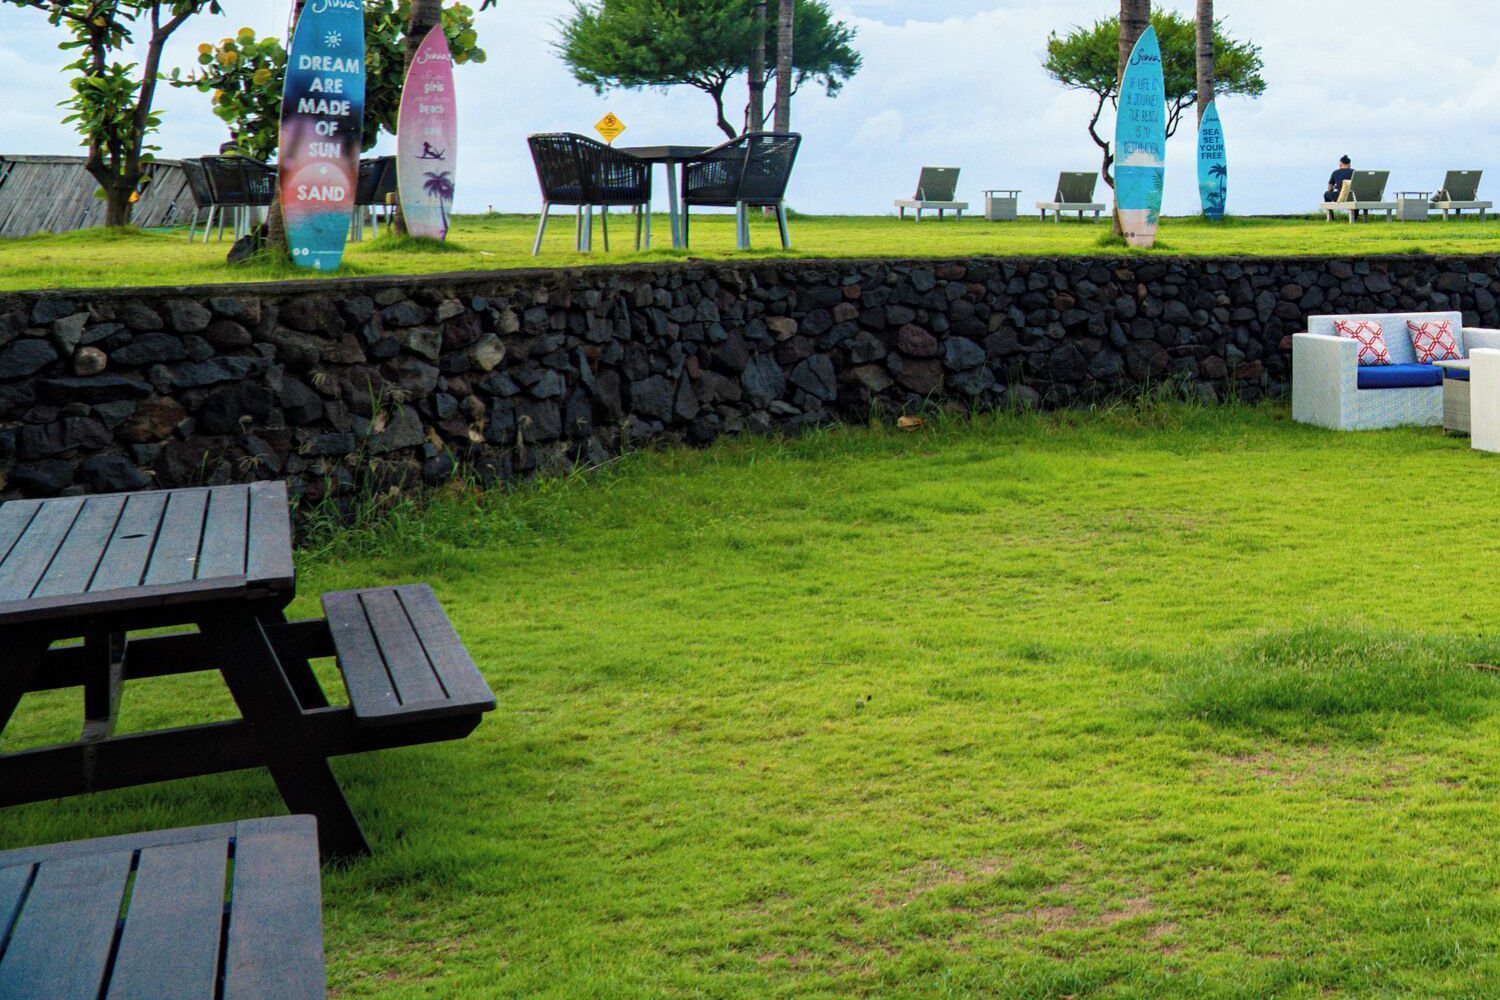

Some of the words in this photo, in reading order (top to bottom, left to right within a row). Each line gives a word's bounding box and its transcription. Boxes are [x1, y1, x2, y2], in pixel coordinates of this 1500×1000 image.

[298, 54, 360, 74] DREAM
[309, 77, 343, 95] ARE
[297, 98, 351, 116] MADE
[315, 120, 339, 137] OF
[1202, 128, 1220, 136] SEA
[308, 141, 341, 159] SUN
[297, 185, 345, 202] SAND
